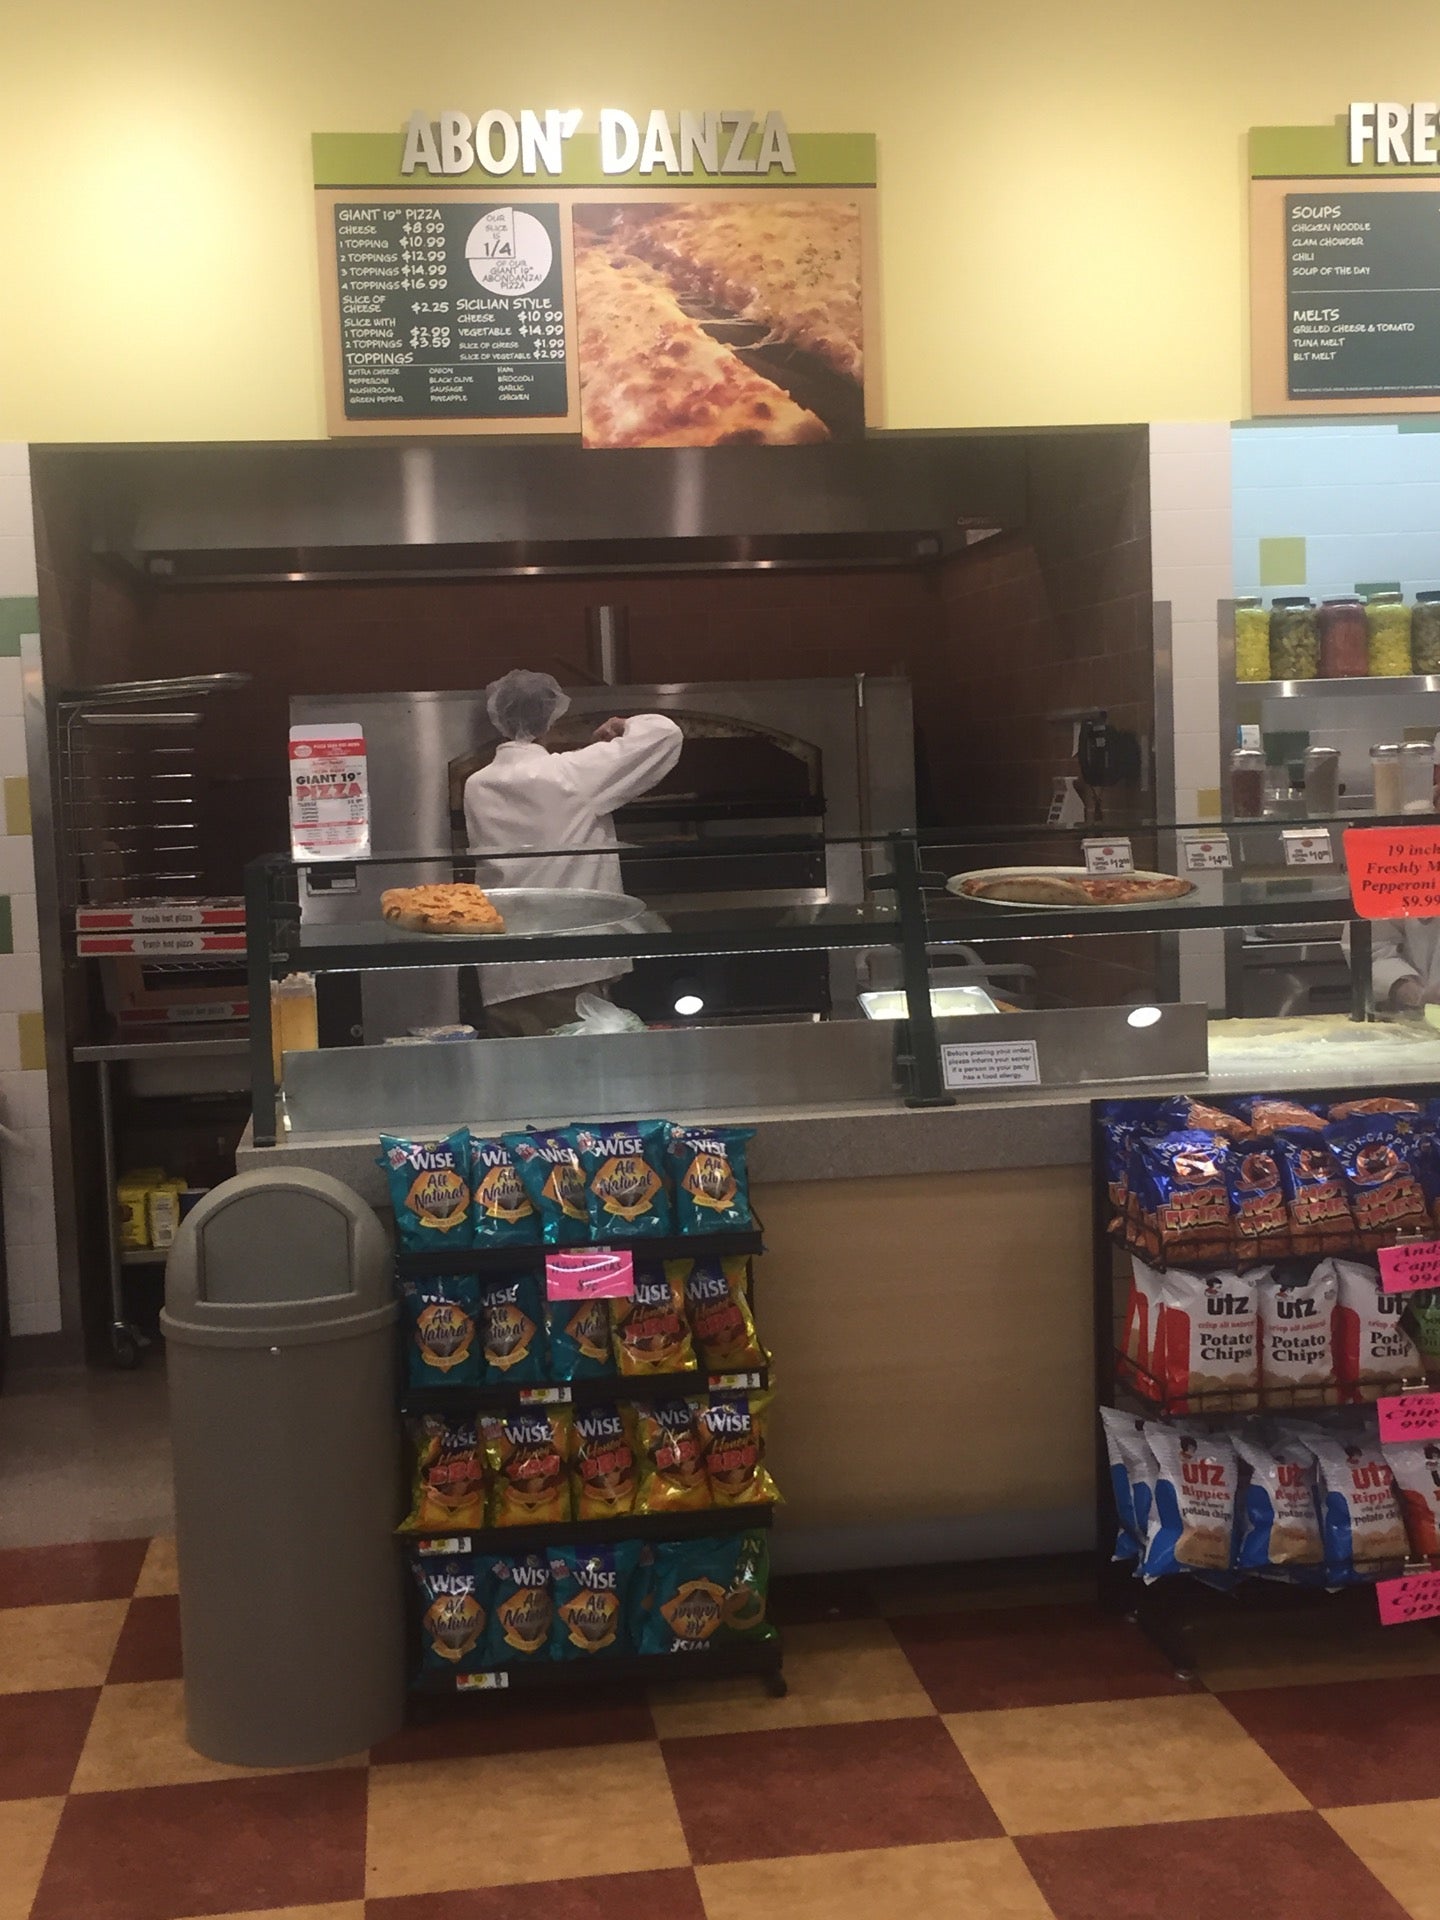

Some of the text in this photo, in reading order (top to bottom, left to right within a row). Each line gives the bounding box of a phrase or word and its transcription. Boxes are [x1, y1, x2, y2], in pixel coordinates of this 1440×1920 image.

[1350, 102, 1440, 163] FRE
[600, 108, 796, 174] DANZA
[339, 209, 380, 221] GIANT
[405, 209, 441, 220] PIZZA
[1292, 205, 1341, 219] SOUPS
[338, 222, 445, 235] CHEESE $8.99
[1292, 222, 1371, 232] CHICKEN NOODLE
[344, 239, 389, 248] TOPPING
[399, 236, 446, 249] $10.99
[484, 240, 512, 257] 1/4
[1292, 237, 1364, 247] CLAM CHOWDER
[348, 253, 398, 262] TOPPINGS
[401, 250, 446, 263] $12.99
[1292, 253, 1315, 261] CHILI
[341, 264, 447, 277] 3 TOPPINGS $14.99
[1292, 266, 1371, 276] SOUP OF THE DAY
[341, 278, 448, 291] 4 TOPPINGS $16.99
[342, 295, 386, 304] SLICE OF
[456, 298, 552, 310] SICILIAN STYLE
[343, 302, 449, 314] CHEESE $2.25
[1293, 308, 1340, 321] MELTS
[344, 317, 396, 327] SLICE WITH
[457, 310, 563, 323] CHEESE $10.99
[350, 329, 394, 338] TOPPING
[410, 326, 450, 338] $2.99
[458, 324, 564, 337] VEGETABLE $14.99
[1293, 323, 1415, 334] GRILLED CHEESE & TOMATO
[352, 339, 403, 348] TOPPINGS
[409, 337, 451, 349] $3.59
[491, 341, 519, 349] CHEESE
[533, 338, 565, 349] $1.99
[1293, 337, 1345, 347] TUNA MELT
[345, 352, 414, 364] TOPPINGS
[491, 352, 531, 360] VEGETABLE
[533, 349, 565, 360] $2.99
[1293, 351, 1336, 361] BLT MELT
[498, 384, 525, 392] GARLIC
[296, 774, 337, 785] GIANT
[295, 782, 363, 801] PIZZA
[1388, 844, 1404, 857] 19
[1367, 861, 1421, 875] Freshly
[1362, 878, 1436, 894] Pepperoni
[175, 913, 193, 924] pizza
[176, 939, 194, 949] pizza
[593, 1138, 644, 1157] WISE
[408, 1152, 455, 1170] WISE
[615, 1160, 636, 1175] All
[427, 1174, 448, 1188] All
[414, 1182, 465, 1209] Natural
[1272, 1335, 1326, 1348] Potato
[1200, 1348, 1252, 1362] Chips
[1272, 1349, 1325, 1364] Chips
[574, 1417, 623, 1437] WISE
[705, 1414, 751, 1432] WISE
[504, 1424, 552, 1444] WISE
